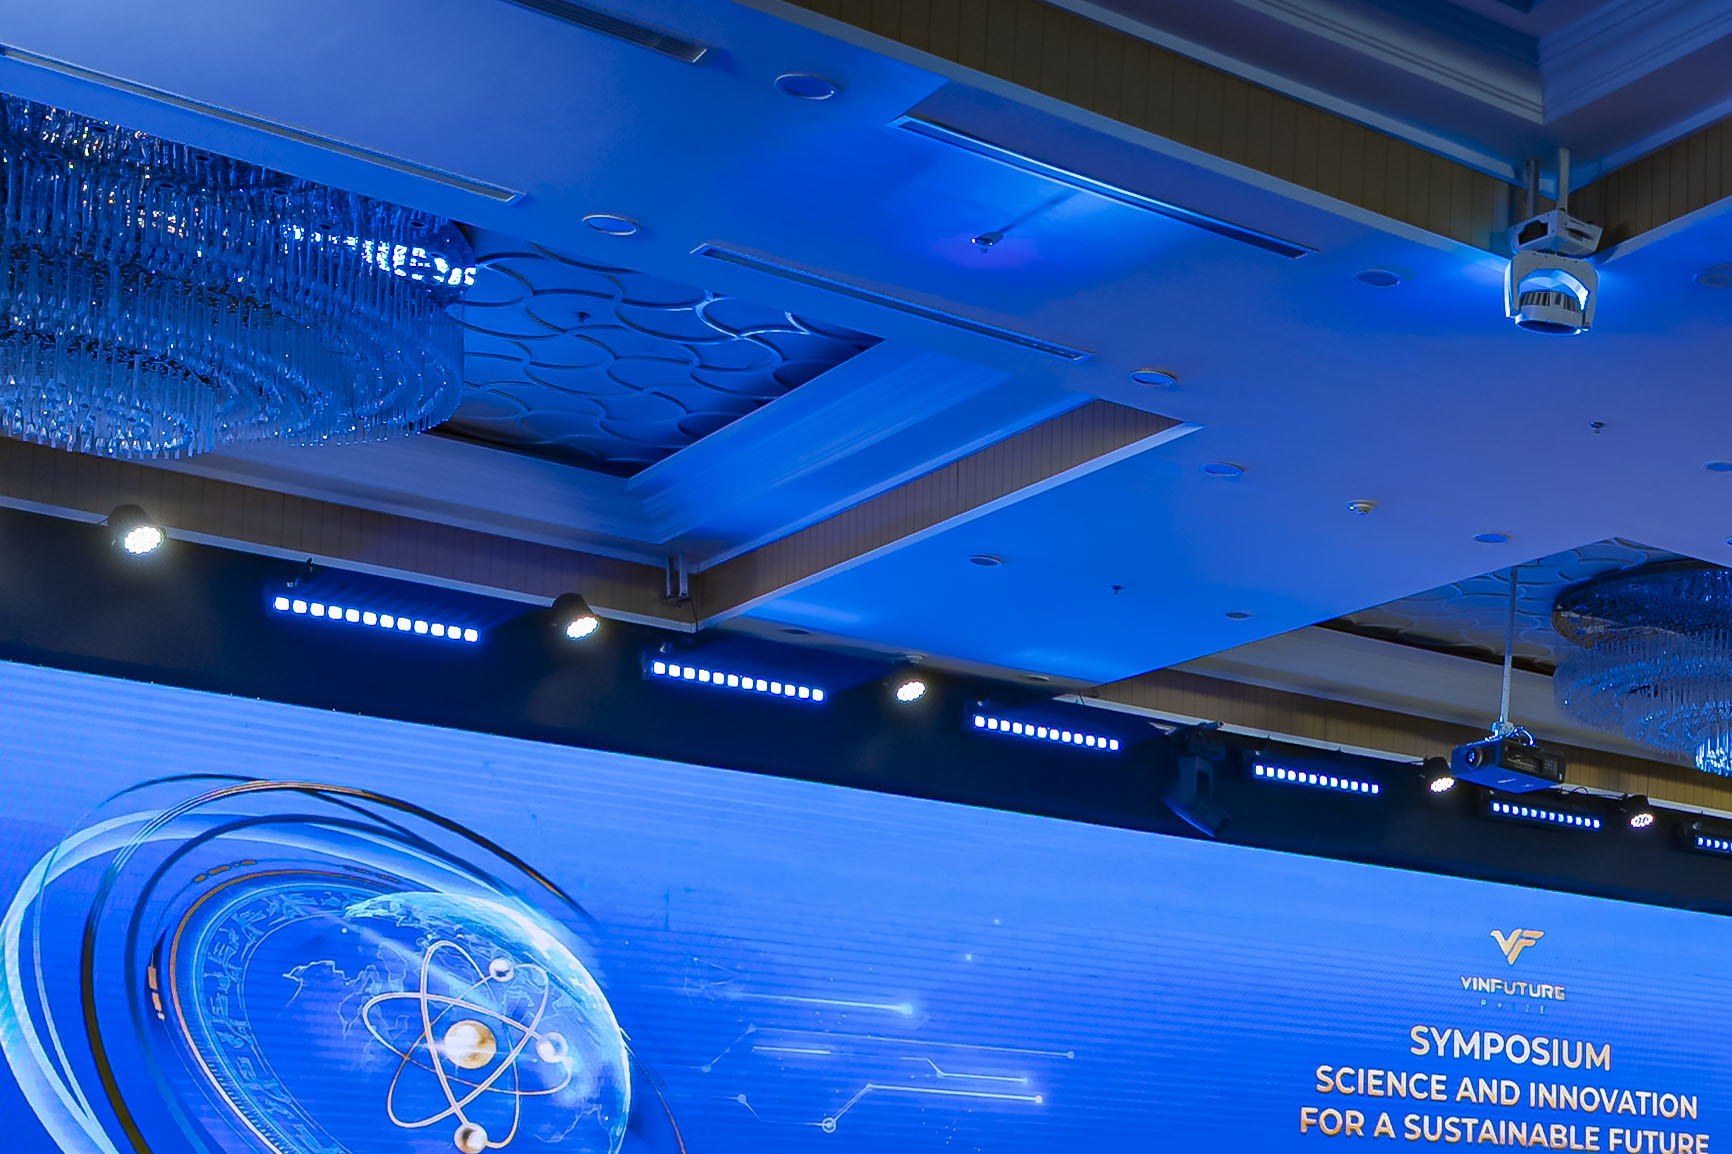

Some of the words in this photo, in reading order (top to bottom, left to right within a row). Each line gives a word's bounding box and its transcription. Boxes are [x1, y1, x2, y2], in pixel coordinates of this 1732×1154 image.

[1460, 975, 1566, 1001] VINFUTURE
[1410, 1025, 1612, 1071] SYMPOSIUM
[1315, 1065, 1448, 1101] SCIENCE
[1456, 1078, 1521, 1107] AND
[1529, 1083, 1698, 1120] INNOVATION
[1300, 1106, 1365, 1138] FOR
[1373, 1112, 1396, 1140] A
[1403, 1113, 1601, 1152] SUSTAINABLE
